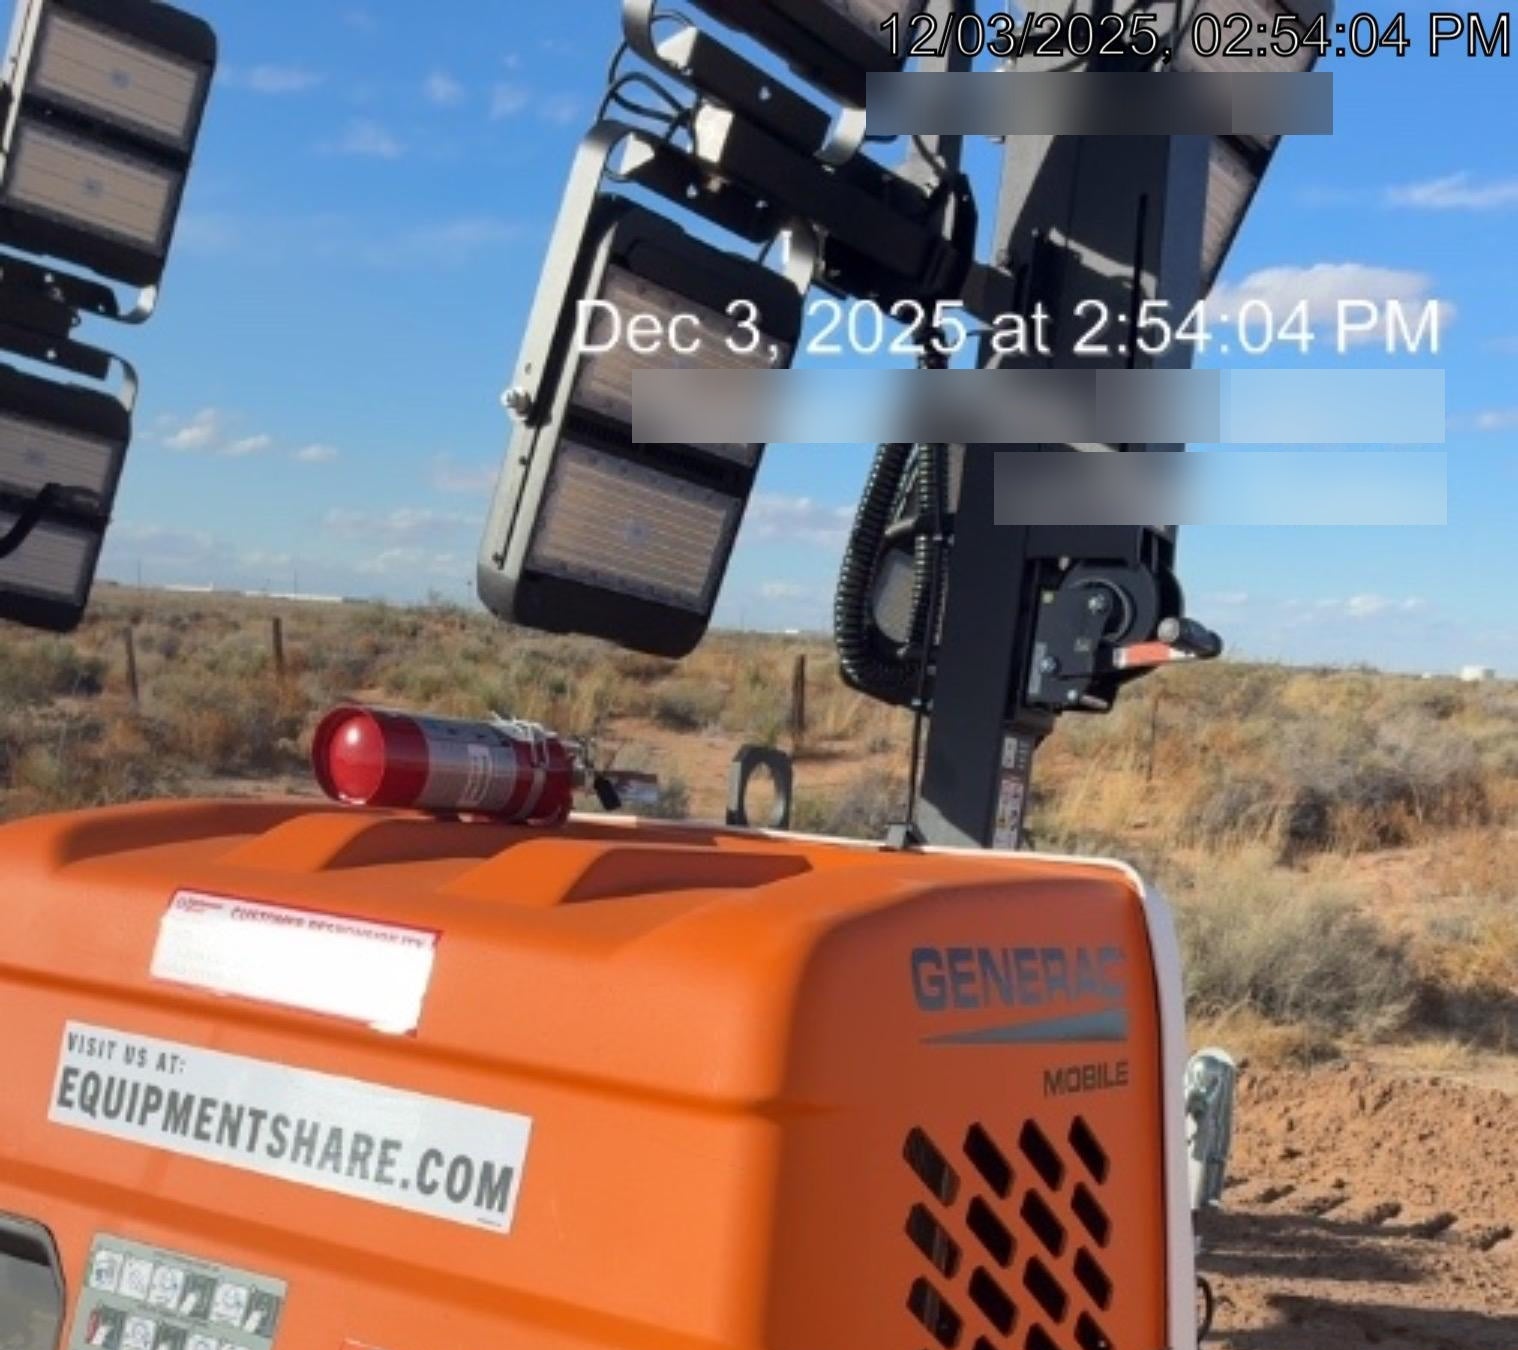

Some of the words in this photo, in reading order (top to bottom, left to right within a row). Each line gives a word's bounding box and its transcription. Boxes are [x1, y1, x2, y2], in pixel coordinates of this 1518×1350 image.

[911, 945, 1127, 1012] GENERAC
[67, 1031, 118, 1061] VISIT
[123, 1043, 148, 1069] US
[155, 1051, 186, 1075] AT:
[1043, 1061, 1129, 1097] MOBILE
[57, 1066, 515, 1213] EQUIPMENTSHARE.COM
